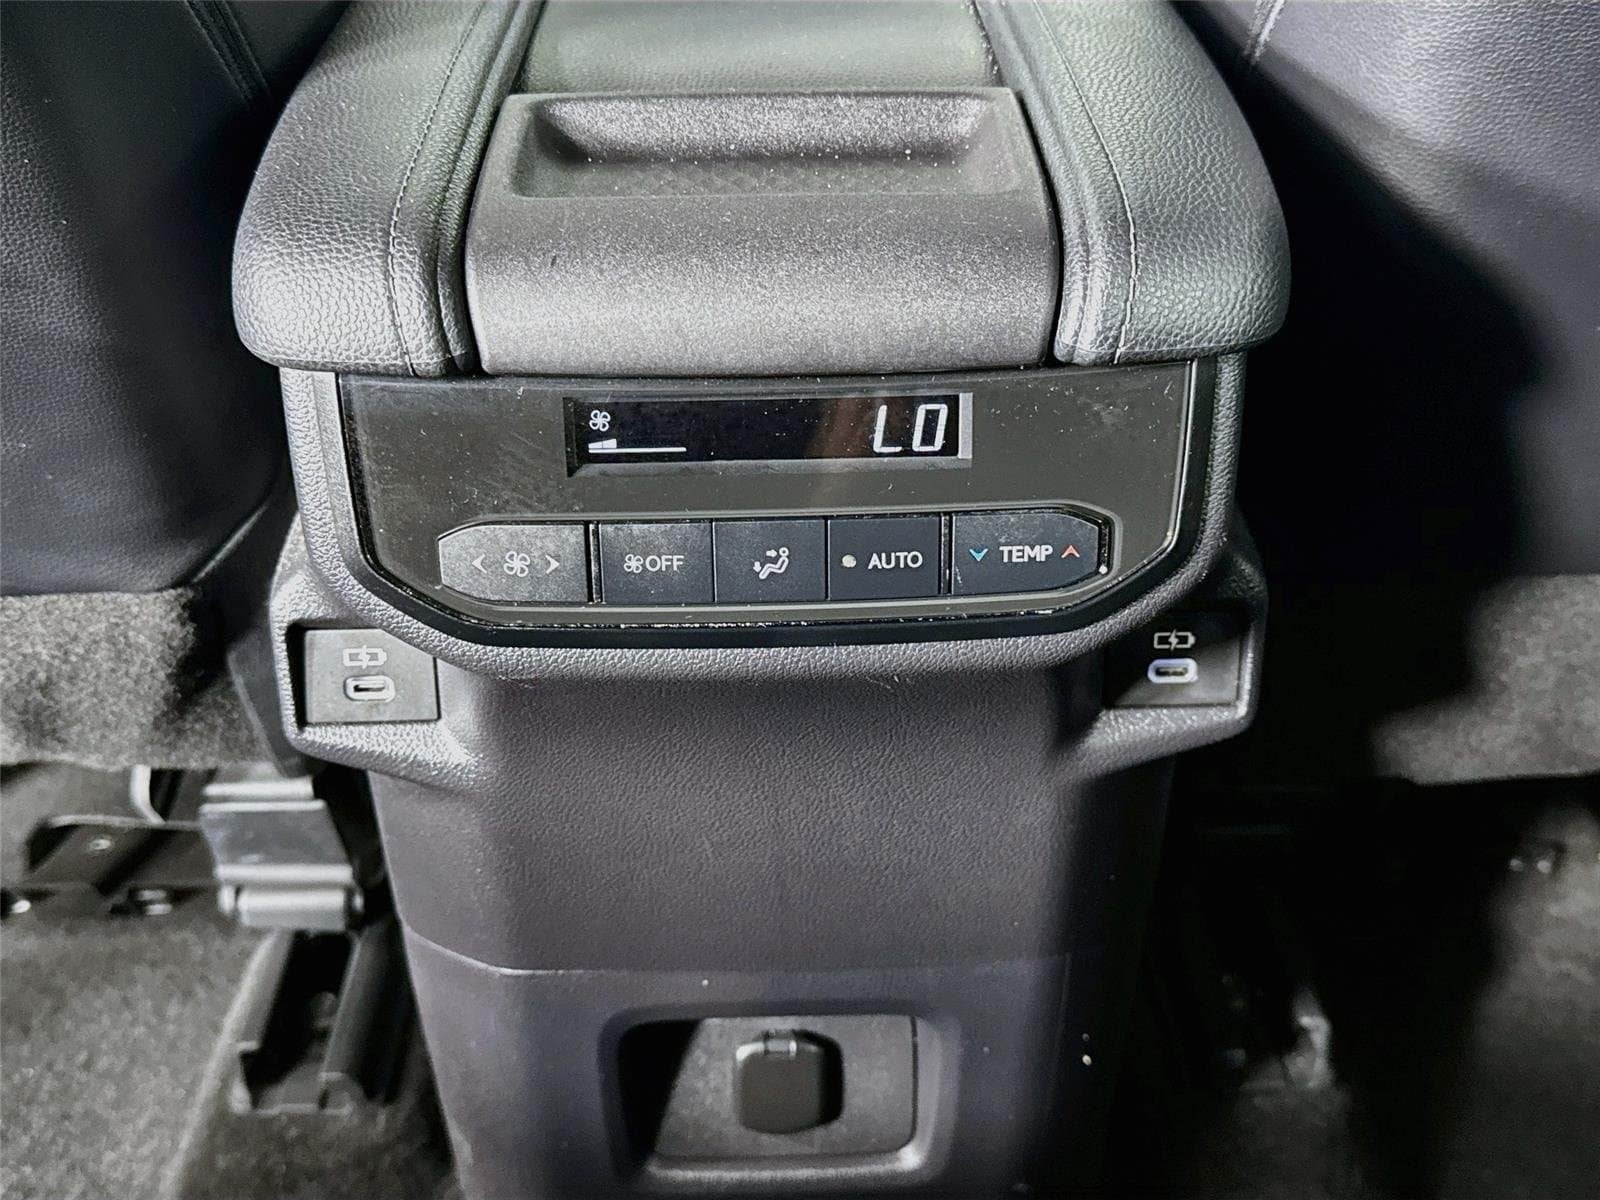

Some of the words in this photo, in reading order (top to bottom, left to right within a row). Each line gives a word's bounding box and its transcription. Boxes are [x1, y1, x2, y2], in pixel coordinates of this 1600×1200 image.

[873, 403, 949, 453] LO
[867, 551, 923, 570] AUTO
[999, 544, 1053, 563] TEMP
[645, 555, 685, 572] OFF
